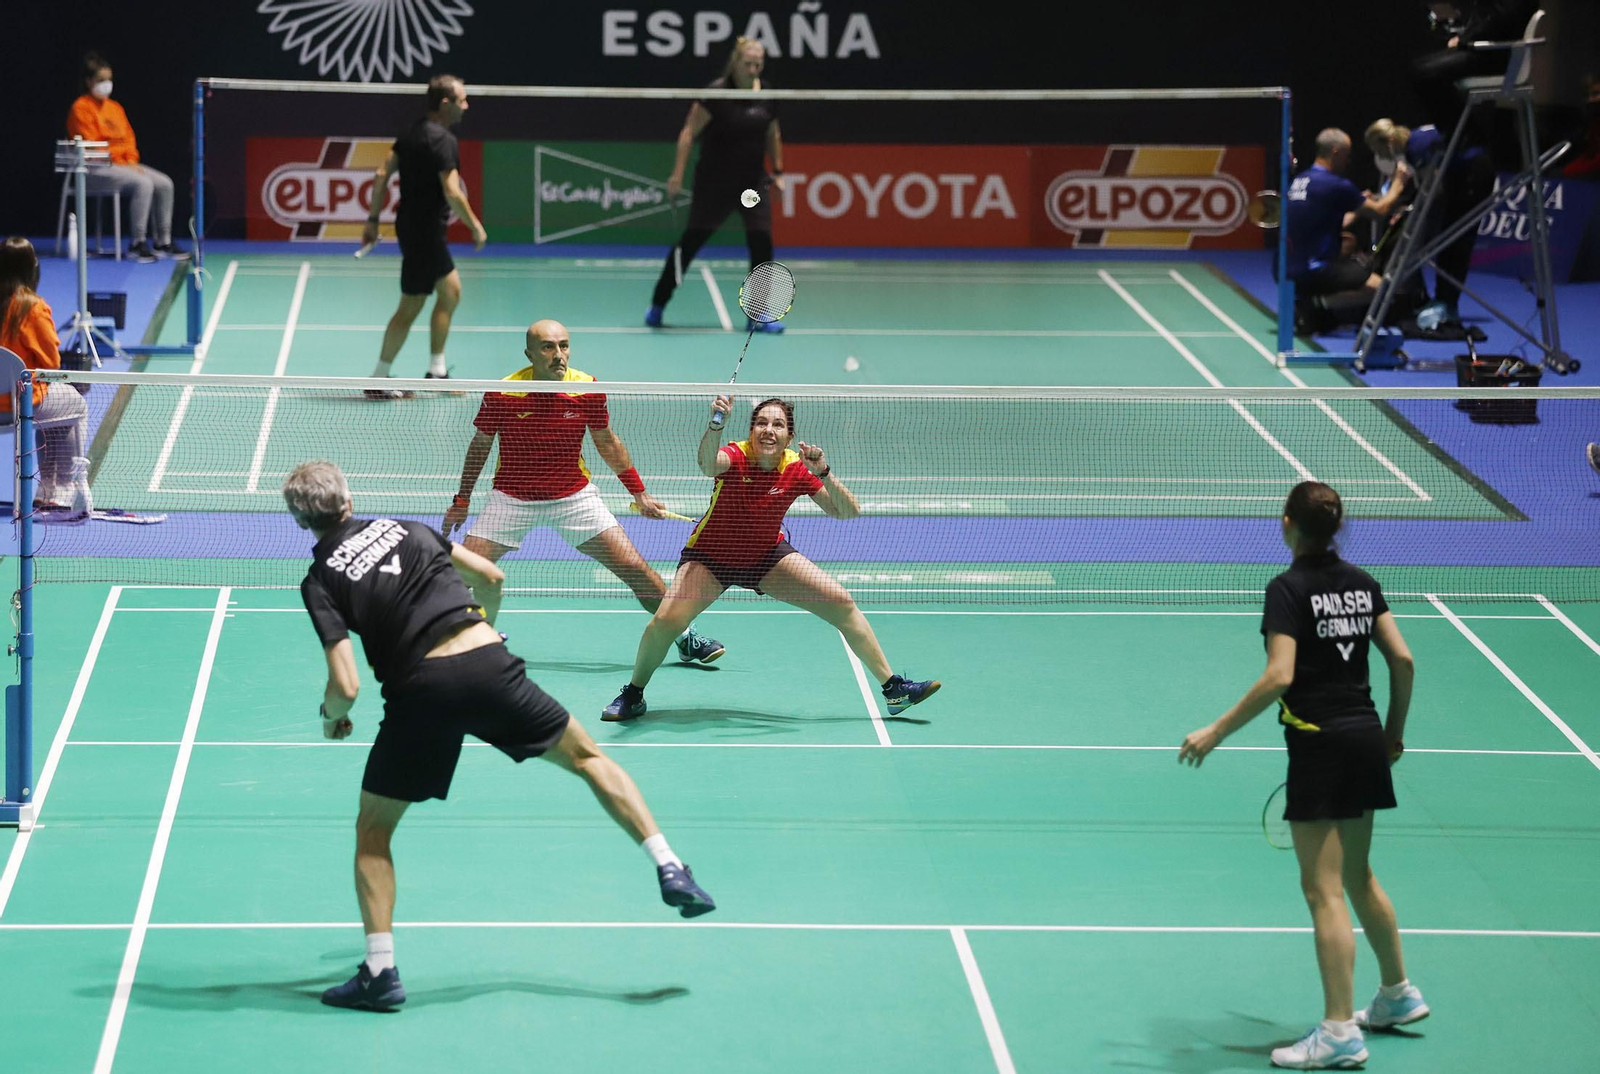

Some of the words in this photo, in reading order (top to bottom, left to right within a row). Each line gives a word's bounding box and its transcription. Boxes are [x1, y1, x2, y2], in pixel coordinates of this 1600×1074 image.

[602, 1, 881, 58] ESPAÑA
[782, 171, 1017, 219] TOYOTA
[345, 524, 409, 581] GERMANY
[1310, 590, 1373, 618] PAULSEN
[1316, 616, 1373, 638] GERMANY
